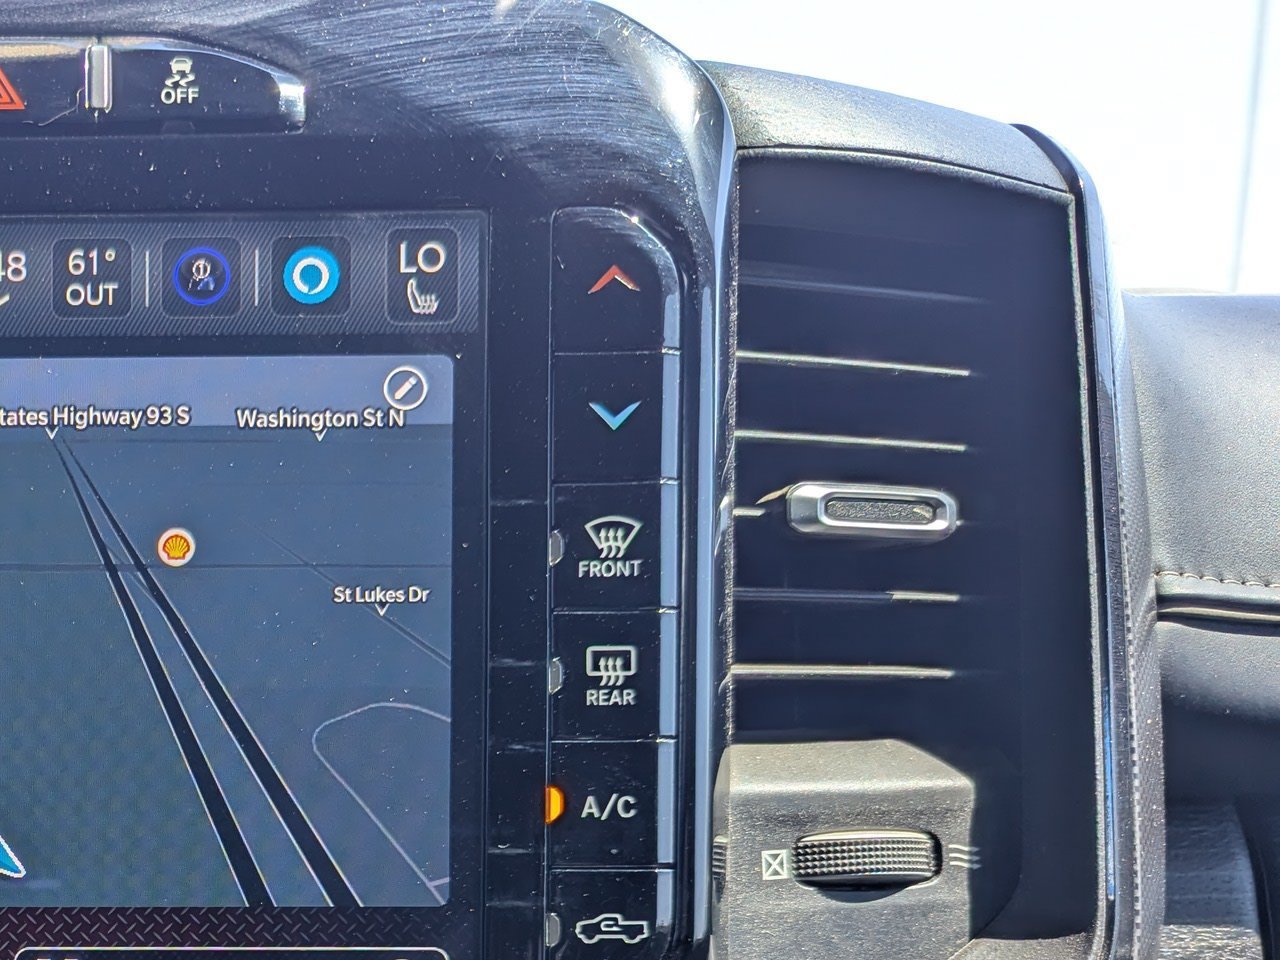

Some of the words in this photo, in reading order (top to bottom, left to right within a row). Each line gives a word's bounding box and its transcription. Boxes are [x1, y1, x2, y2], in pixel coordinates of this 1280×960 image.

[161, 87, 199, 104] OFF
[67, 247, 117, 277] 61°
[399, 240, 446, 274] LO
[65, 283, 119, 307] OUT
[53, 408, 143, 431] Highway
[145, 408, 175, 426] 93
[177, 408, 191, 426] S
[237, 408, 358, 432] Washington
[362, 409, 387, 428] St
[389, 408, 406, 428] N
[578, 559, 642, 579] FRONT
[333, 585, 352, 603] St
[355, 585, 404, 603] Lukes
[408, 586, 431, 604] Dr
[586, 689, 637, 706] REAR
[581, 795, 638, 821] A/C
